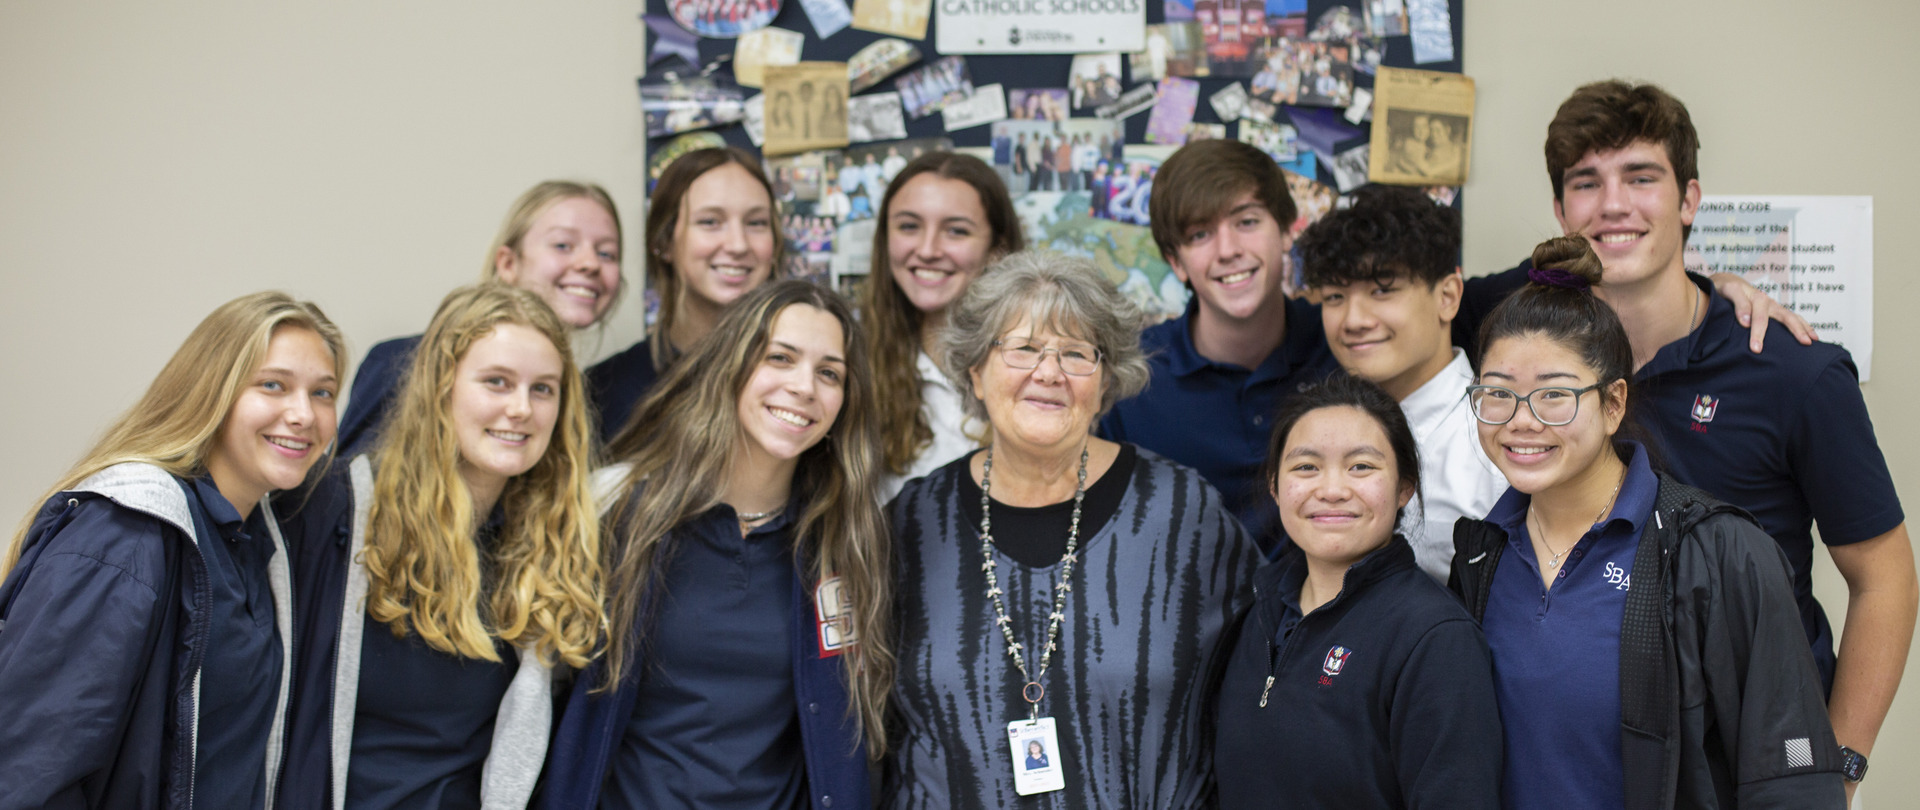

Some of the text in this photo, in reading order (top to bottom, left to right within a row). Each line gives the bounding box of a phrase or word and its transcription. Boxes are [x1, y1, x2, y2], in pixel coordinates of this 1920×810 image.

[941, 0, 1140, 15] CATHOLIC SCHOOLS
[1697, 202, 1771, 212] ONOR CODE
[1702, 224, 1750, 233] member
[1755, 224, 1767, 233] of
[1770, 224, 1789, 233] the
[1705, 244, 1716, 252] at
[1721, 244, 1788, 252] Auburndale
[1792, 244, 1836, 253] student
[1707, 263, 1719, 271] of
[1722, 263, 1766, 273] respect
[1770, 263, 1786, 272] for
[1790, 265, 1807, 273] my
[1781, 283, 1804, 291] that
[1817, 283, 1845, 291] have
[1800, 303, 1820, 312] any
[1809, 321, 1843, 330] ment.
[1603, 561, 1631, 591] SBA
[1318, 675, 1333, 686] SBA
